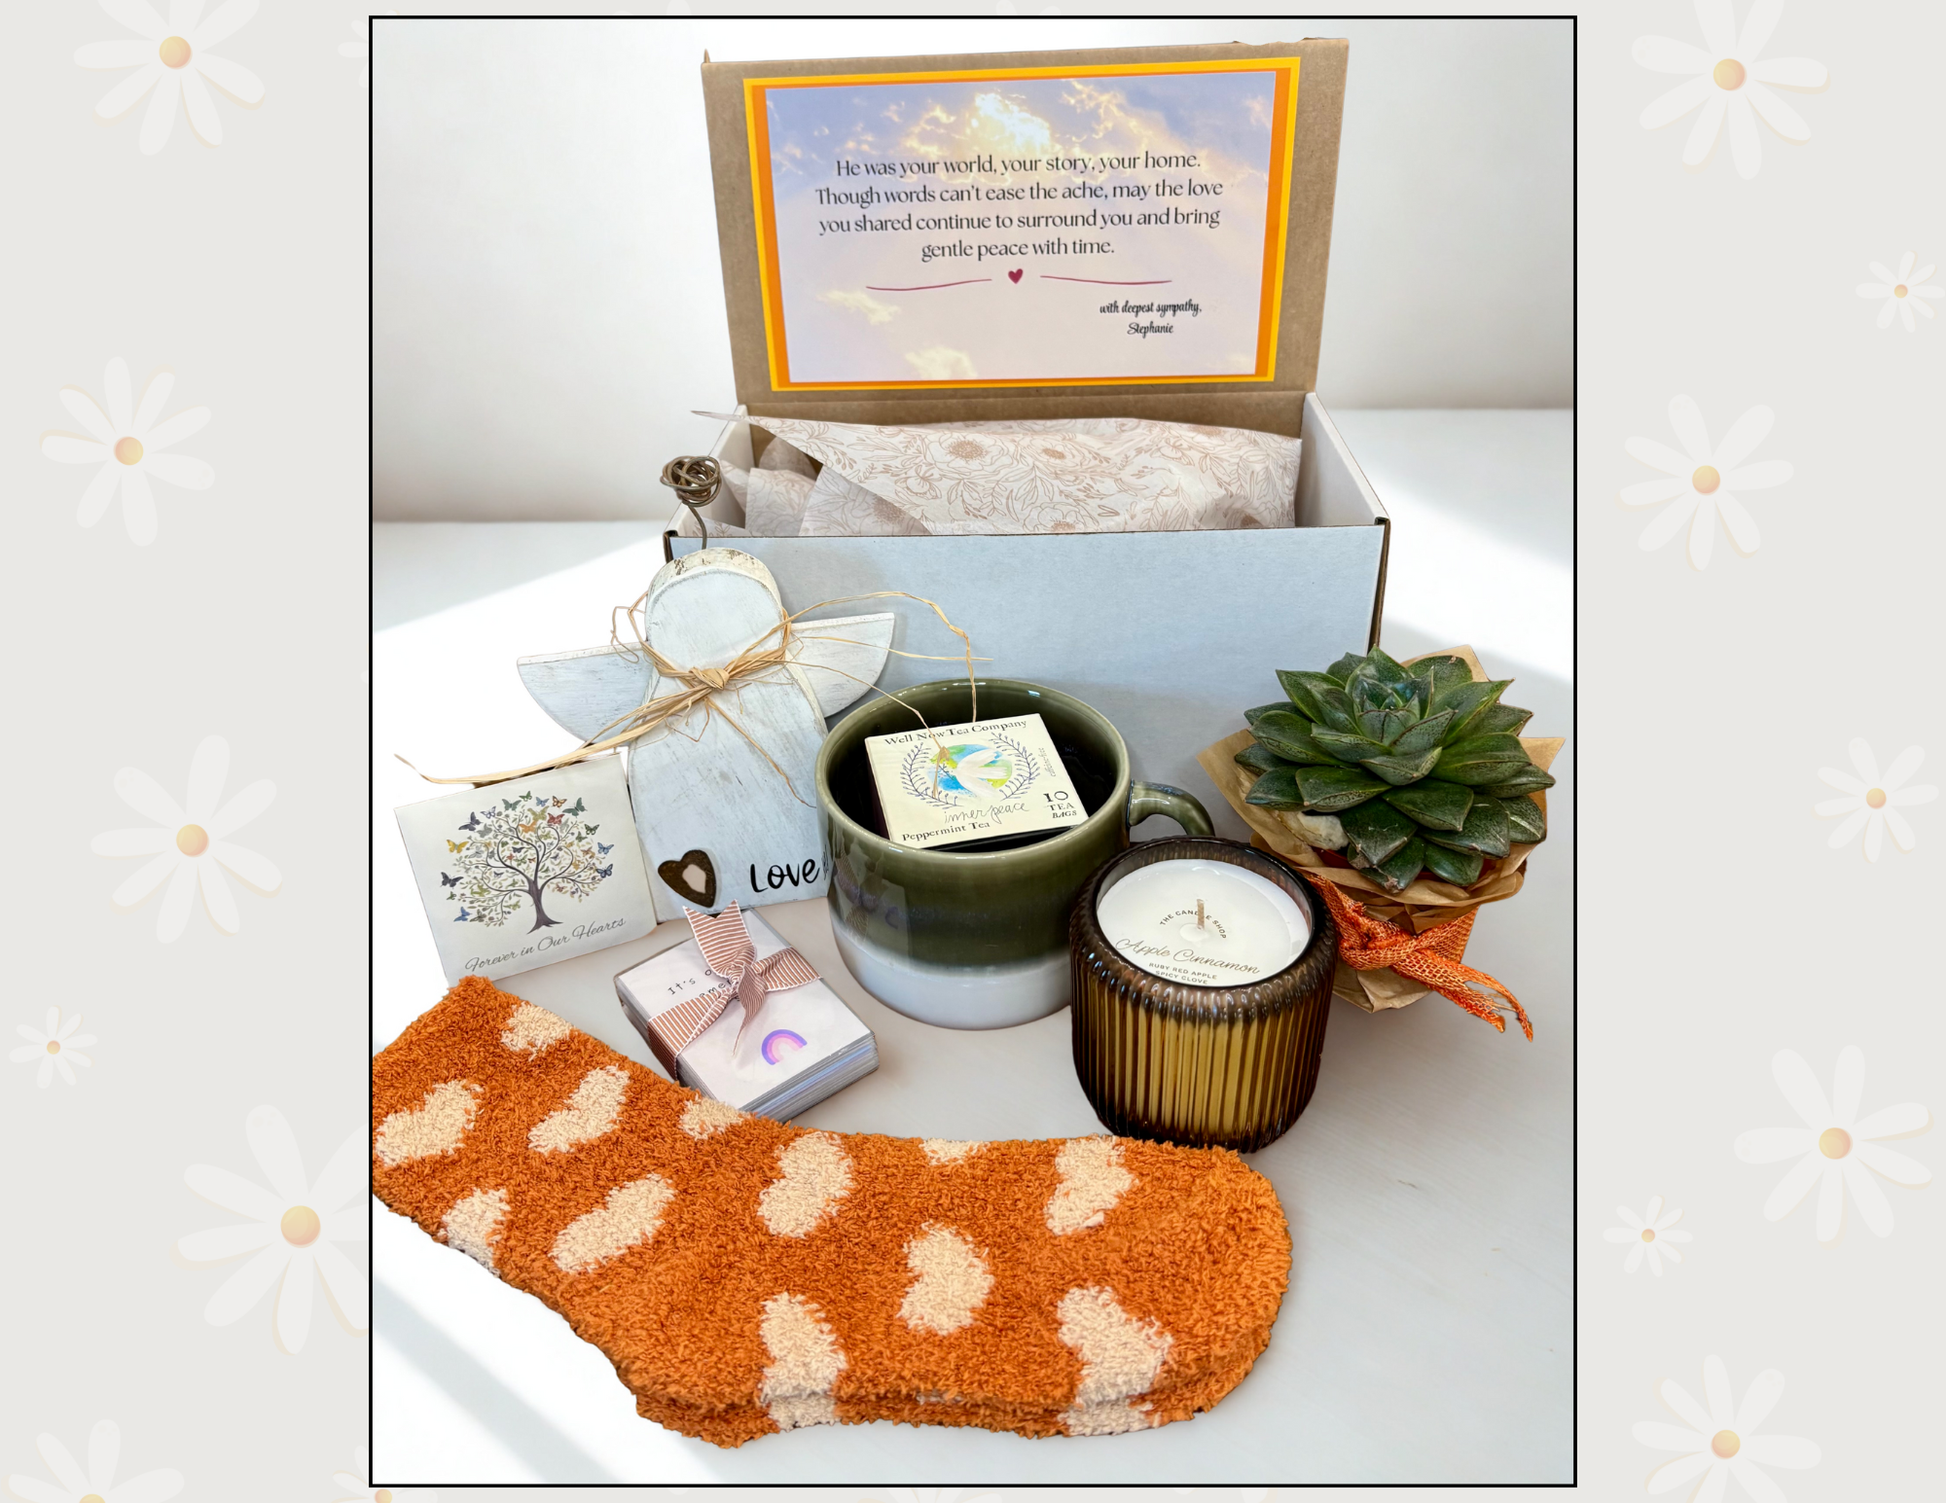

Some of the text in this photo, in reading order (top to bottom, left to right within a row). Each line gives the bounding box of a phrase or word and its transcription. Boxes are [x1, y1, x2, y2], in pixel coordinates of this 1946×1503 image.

[837, 151, 1201, 178] He was your world, your story, your home.
[815, 186, 881, 209] Though
[884, 185, 936, 204] words
[985, 188, 1025, 201] ease
[1030, 182, 1058, 200] the
[1062, 181, 1108, 200] ache,
[1112, 184, 1151, 201] may
[1155, 179, 1184, 197] the
[1188, 178, 1223, 196] love
[819, 206, 1221, 236] you shared continue to surround you and bring
[921, 237, 1115, 263] gentle peace with time.
[1099, 300, 1119, 313] with
[1121, 299, 1154, 318] deepest
[1127, 320, 1174, 339] Stephanie
[884, 719, 1028, 746] Well Now Tea Company
[1043, 790, 1069, 803] 10
[1045, 802, 1075, 811] TEA
[943, 802, 1030, 824] inner peace
[1052, 810, 1077, 819] BAGS
[902, 821, 991, 842] Peppermint Tea
[1159, 913, 1174, 925] THE
[1212, 919, 1227, 939] SHOP
[465, 918, 627, 972] Forever in Our Hearts
[1115, 938, 1261, 975] Apple Cinnamon
[1148, 962, 1218, 980] RUBY RED APPLE
[1155, 970, 1208, 985] SPICY CLOVE
